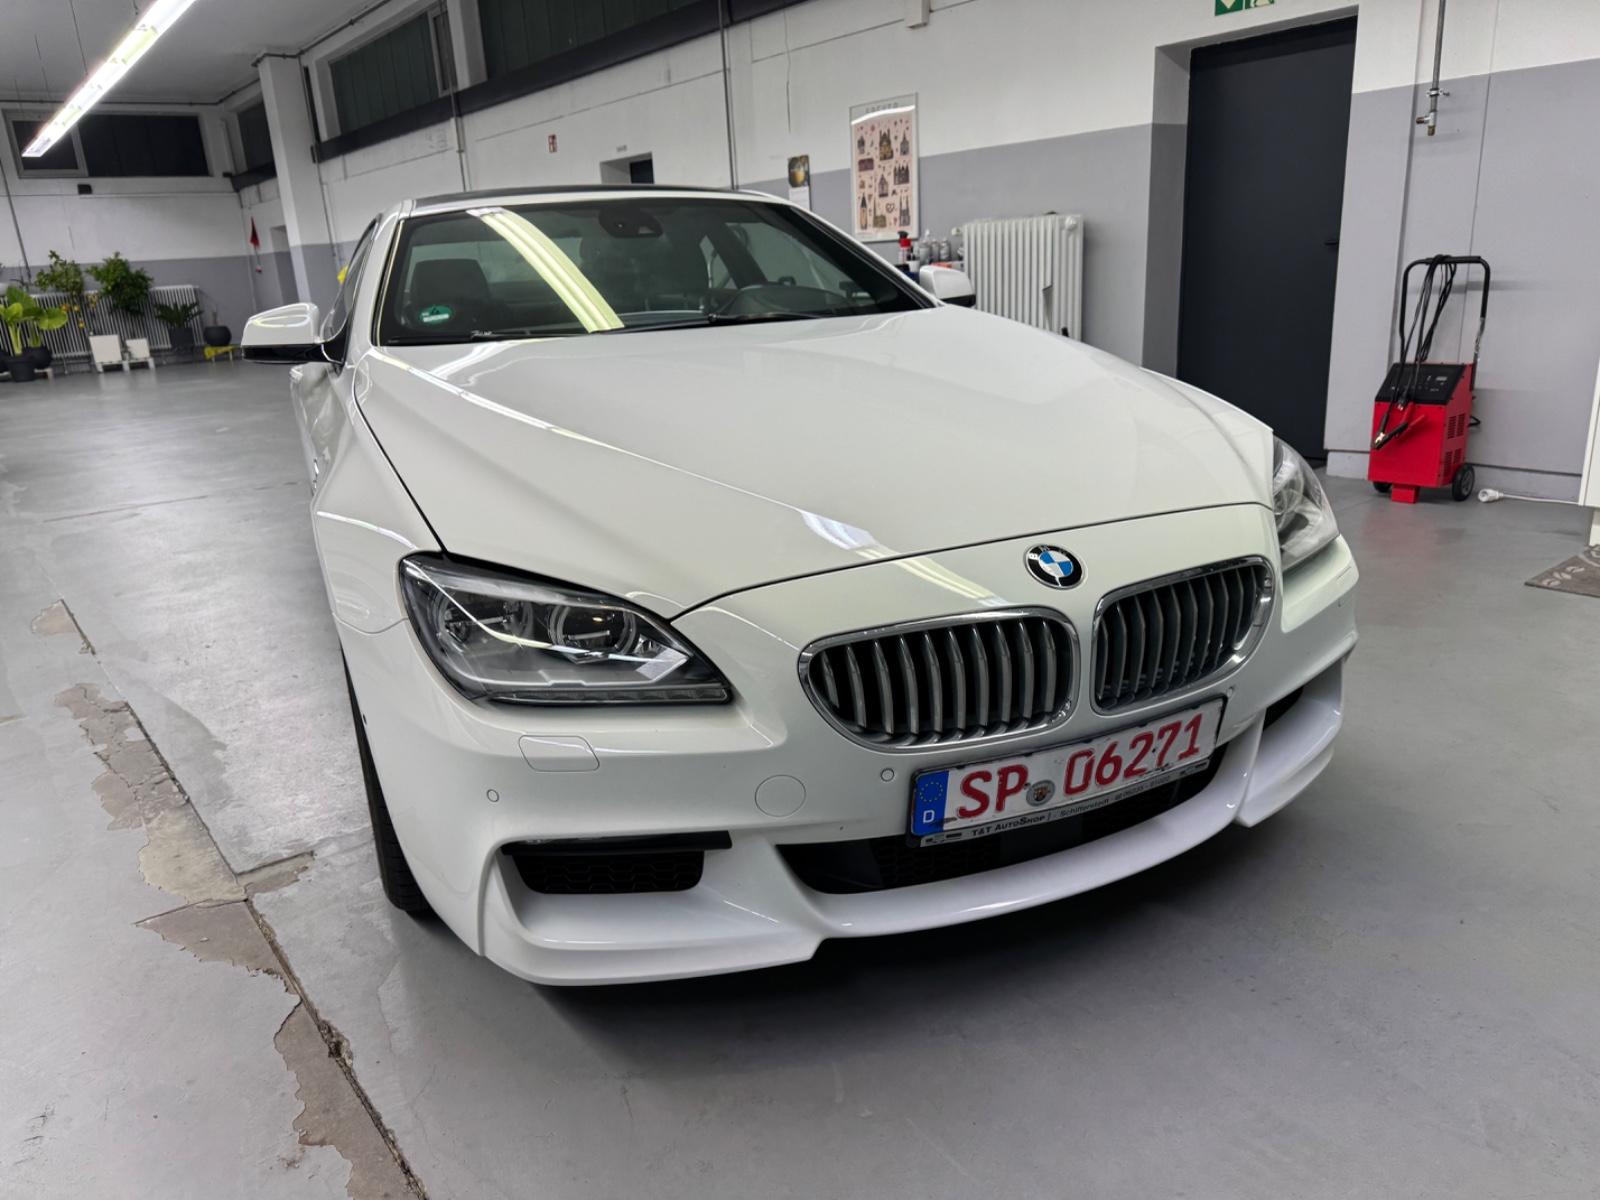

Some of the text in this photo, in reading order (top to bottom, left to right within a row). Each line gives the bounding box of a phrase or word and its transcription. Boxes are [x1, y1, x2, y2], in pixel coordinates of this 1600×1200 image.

[956, 763, 1029, 819] SP
[1063, 713, 1204, 796] 06271
[922, 809, 936, 824] D
